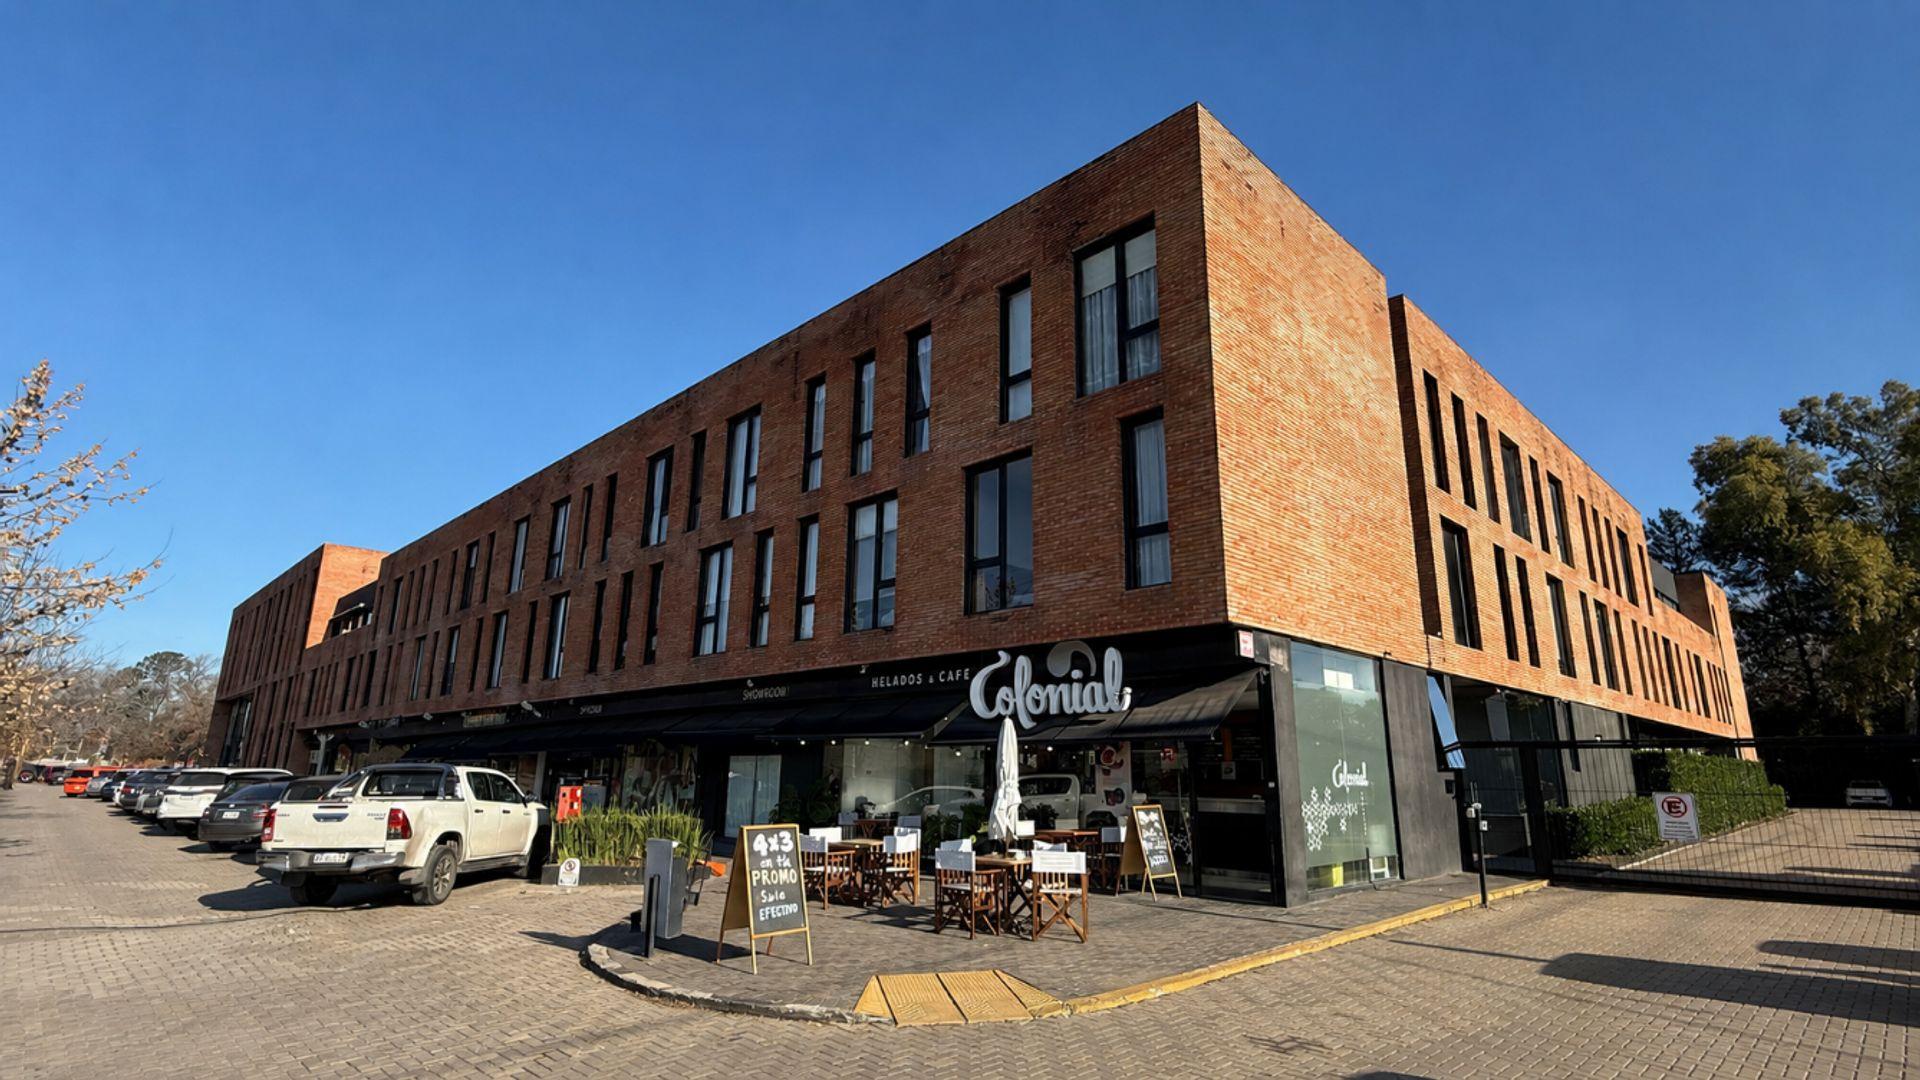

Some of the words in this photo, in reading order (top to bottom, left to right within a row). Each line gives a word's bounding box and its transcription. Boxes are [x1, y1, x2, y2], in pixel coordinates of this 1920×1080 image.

[871, 673, 923, 688] HELADOS
[938, 668, 970, 682] CAFE
[970, 647, 1132, 730] Colonial
[752, 830, 794, 857] 4x3
[751, 868, 798, 887] PROMO
[759, 903, 799, 921] EFECTIVO
